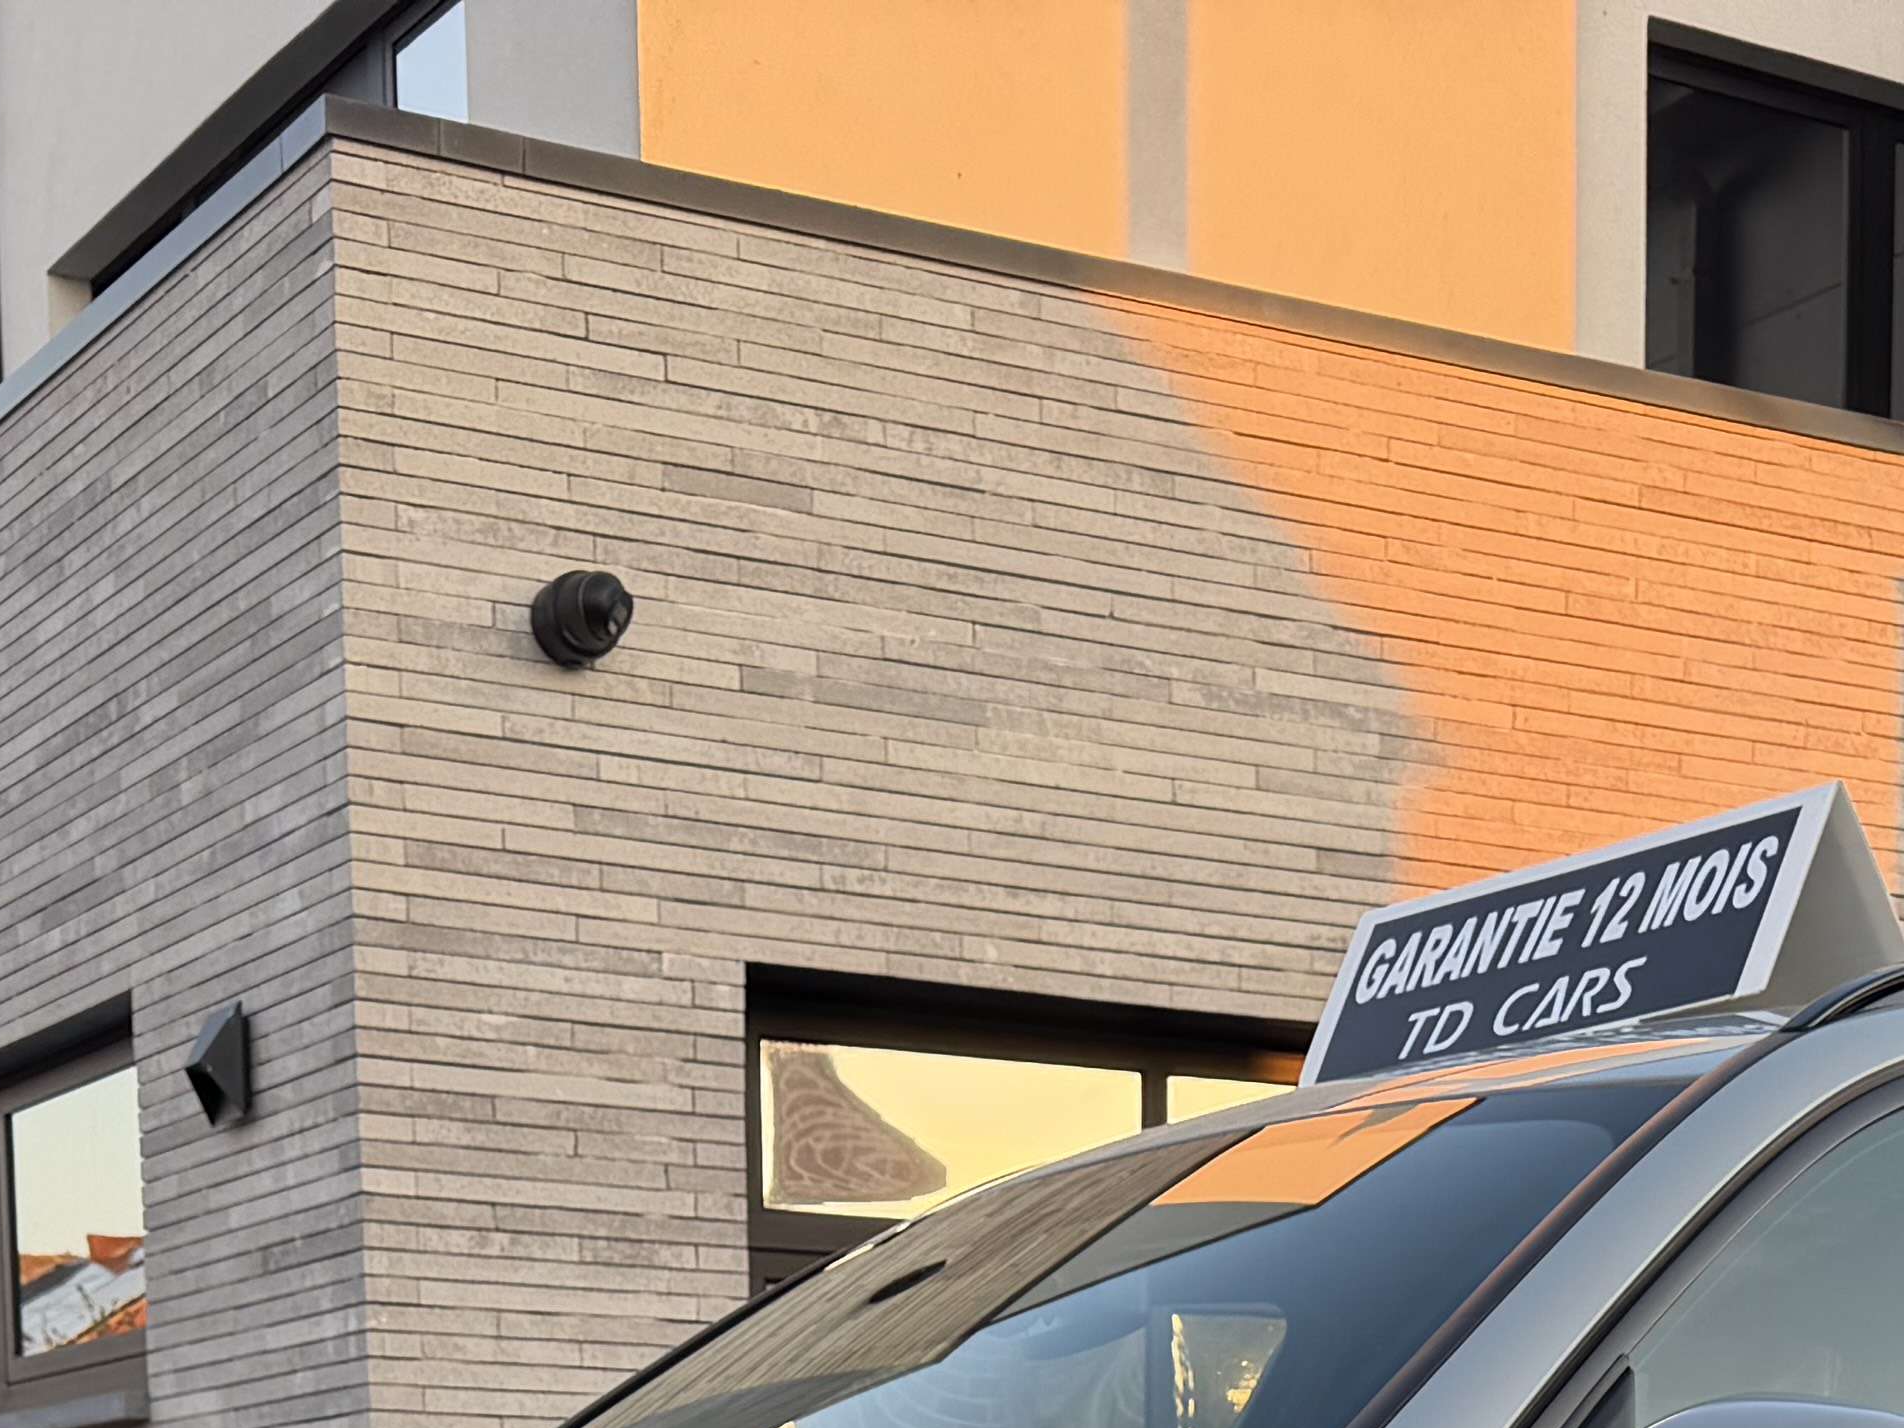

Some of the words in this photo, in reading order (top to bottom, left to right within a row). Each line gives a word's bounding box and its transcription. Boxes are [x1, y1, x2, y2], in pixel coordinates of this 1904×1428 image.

[1356, 889, 1585, 1004] GARANTIE
[1582, 872, 1645, 947] 12
[1638, 836, 1778, 933] MOIS
[1399, 1001, 1473, 1059] TD
[1493, 957, 1647, 1035] CARS
